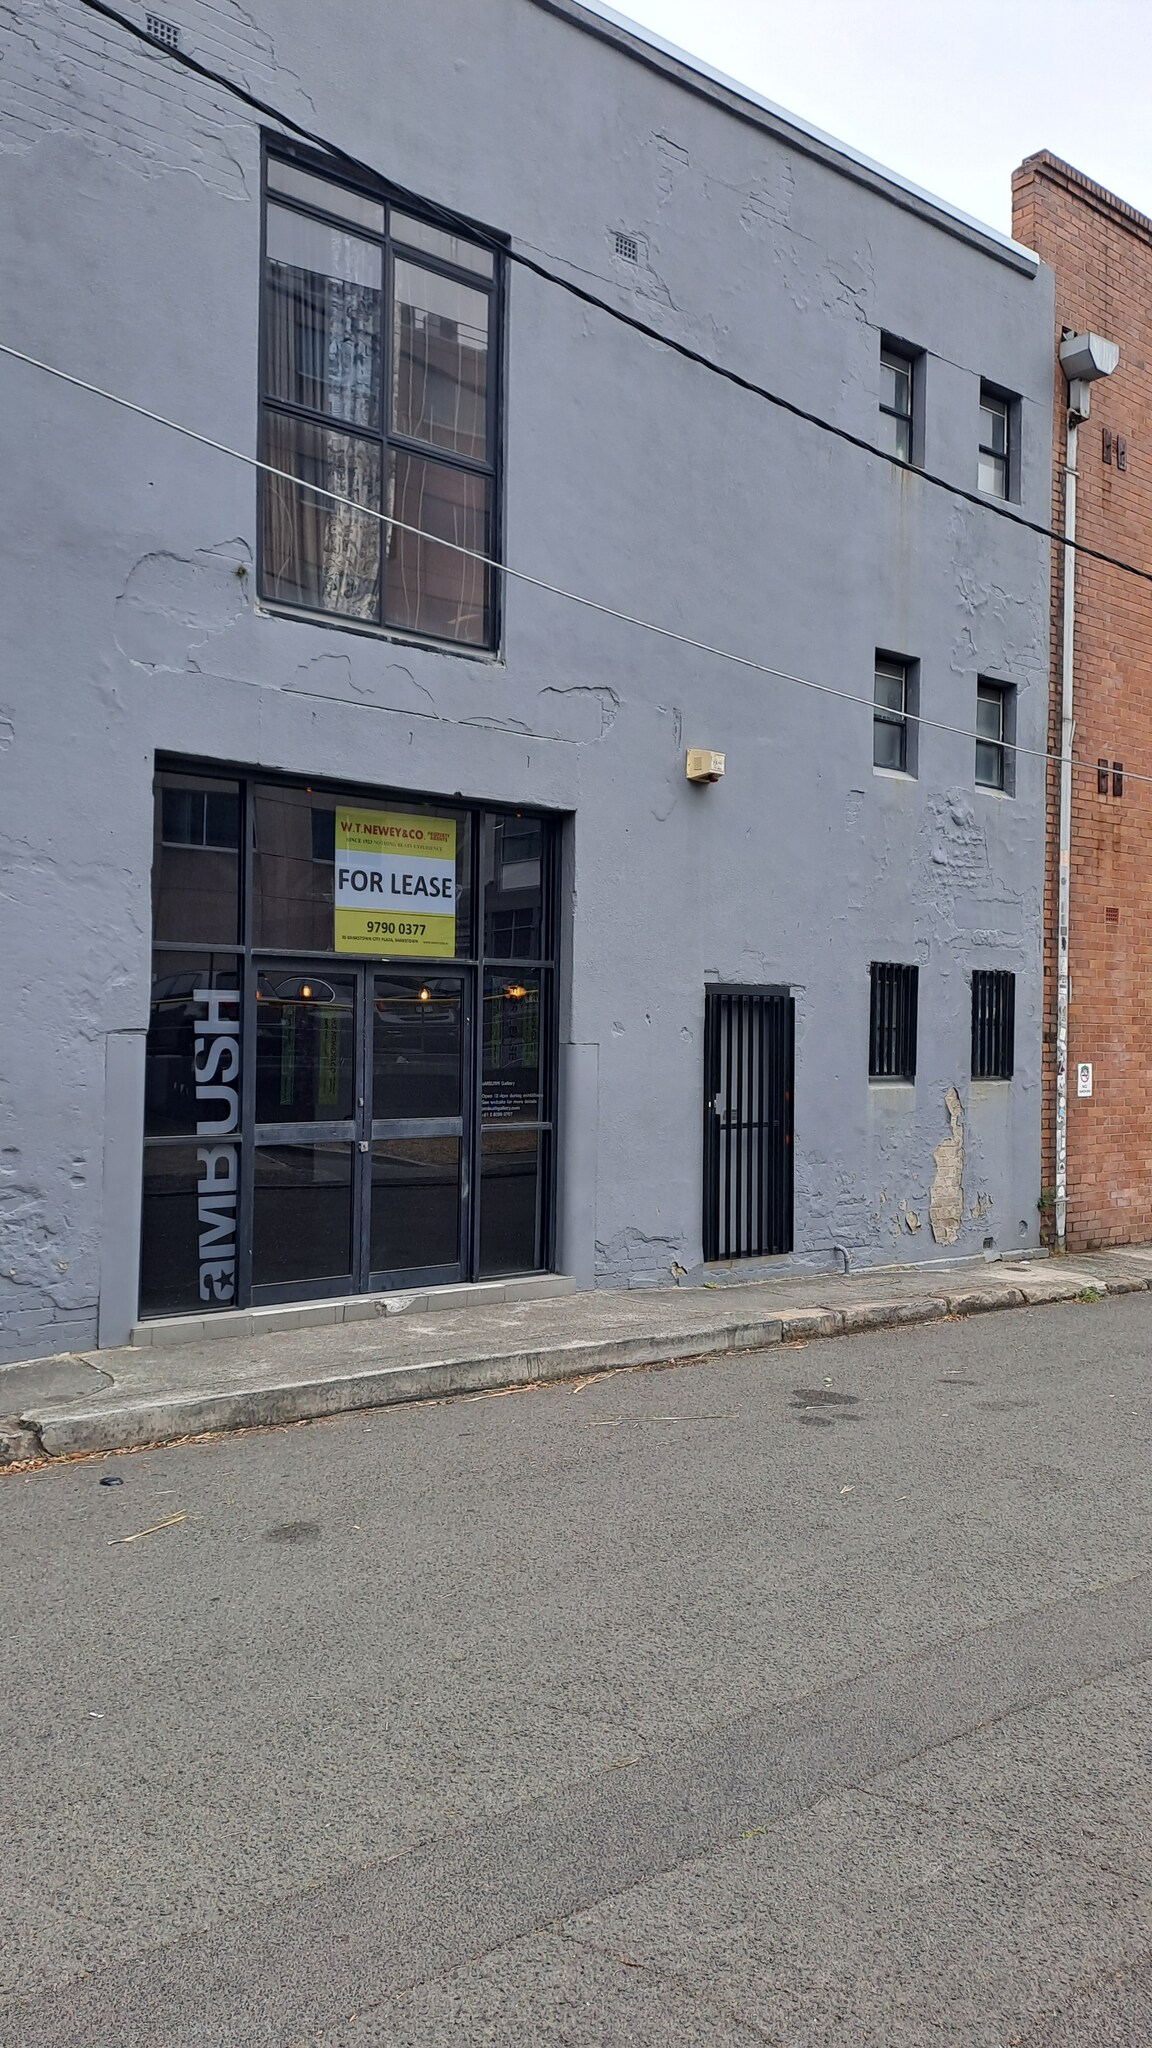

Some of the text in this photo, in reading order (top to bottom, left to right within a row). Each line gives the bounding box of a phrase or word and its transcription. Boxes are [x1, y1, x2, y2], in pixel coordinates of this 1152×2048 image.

[341, 821, 426, 841] W.T.NEWEY&CO.
[339, 869, 452, 898] FOR LEASE
[366, 921, 427, 936] 9790 0377
